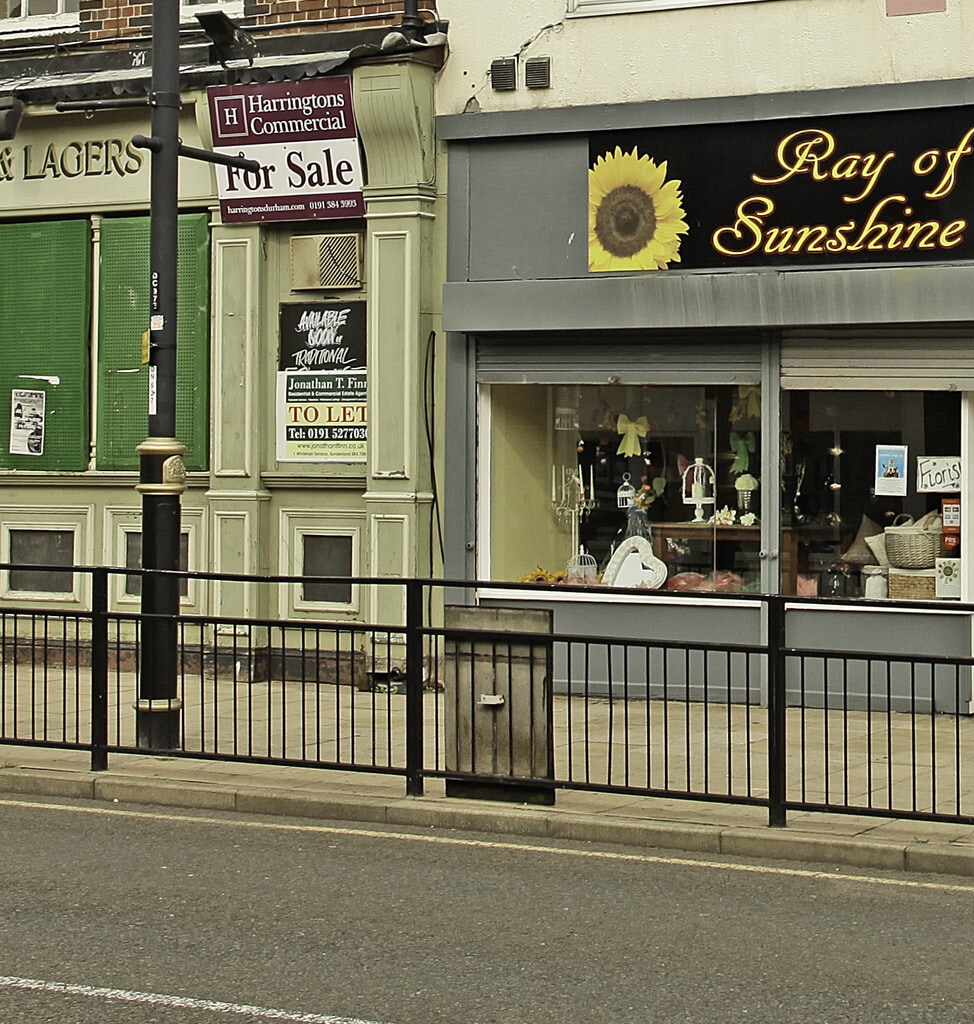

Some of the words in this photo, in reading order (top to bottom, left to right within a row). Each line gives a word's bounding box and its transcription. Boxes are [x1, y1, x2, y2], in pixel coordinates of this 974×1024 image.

[247, 91, 345, 115] Harringtons
[224, 107, 239, 126] H
[250, 110, 347, 136] Commercial
[23, 137, 145, 181] LAGERS
[226, 154, 276, 192] For
[286, 148, 354, 189] Sale
[752, 127, 895, 204] Ray
[227, 203, 305, 215] harringtonsdurham.com
[309, 201, 325, 210] 0191
[712, 195, 968, 256] Sunshine
[288, 378, 333, 390] Jonathan
[335, 377, 345, 389] T.
[288, 406, 319, 423] TO
[326, 406, 367, 423] LET
[288, 427, 306, 439] Tel:
[307, 427, 329, 439] 0191
